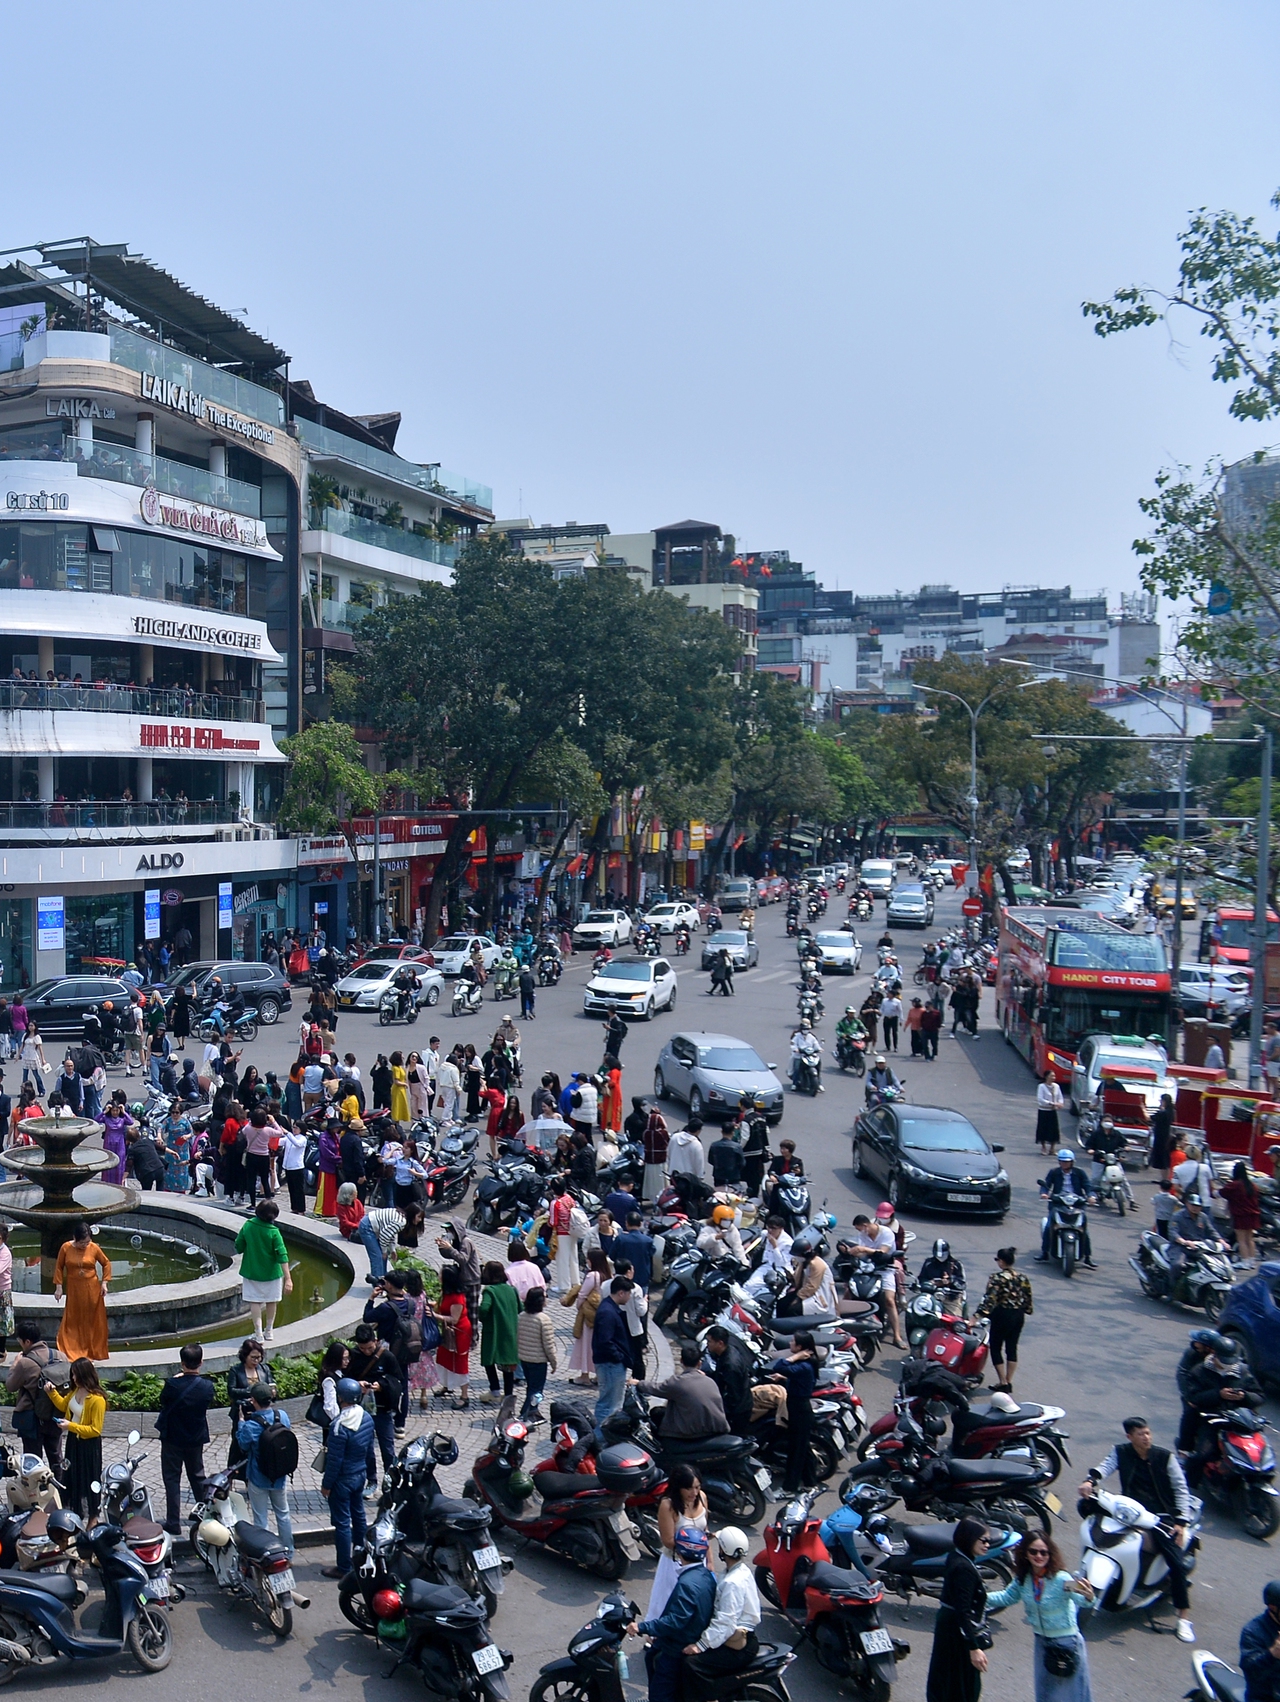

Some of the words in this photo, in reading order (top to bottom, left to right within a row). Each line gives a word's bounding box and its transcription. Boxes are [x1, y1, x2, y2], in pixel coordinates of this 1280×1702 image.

[46, 398, 102, 418] LAIKA
[141, 371, 188, 412] LAIKA
[188, 390, 206, 419] Café
[207, 406, 226, 426] The
[227, 414, 275, 445] Exceptional
[51, 492, 69, 510] 10
[160, 504, 190, 529] VUA
[192, 510, 220, 536] CHẢ
[222, 517, 239, 541] CÁ
[135, 616, 216, 642] HIGHLANDS
[216, 630, 262, 650] COFFEE
[412, 825, 442, 836] LOTTERIA
[136, 852, 184, 871] ALDO
[1062, 973, 1098, 983] HANOI
[1101, 976, 1126, 985] CITY
[1129, 977, 1157, 987] TOUR
